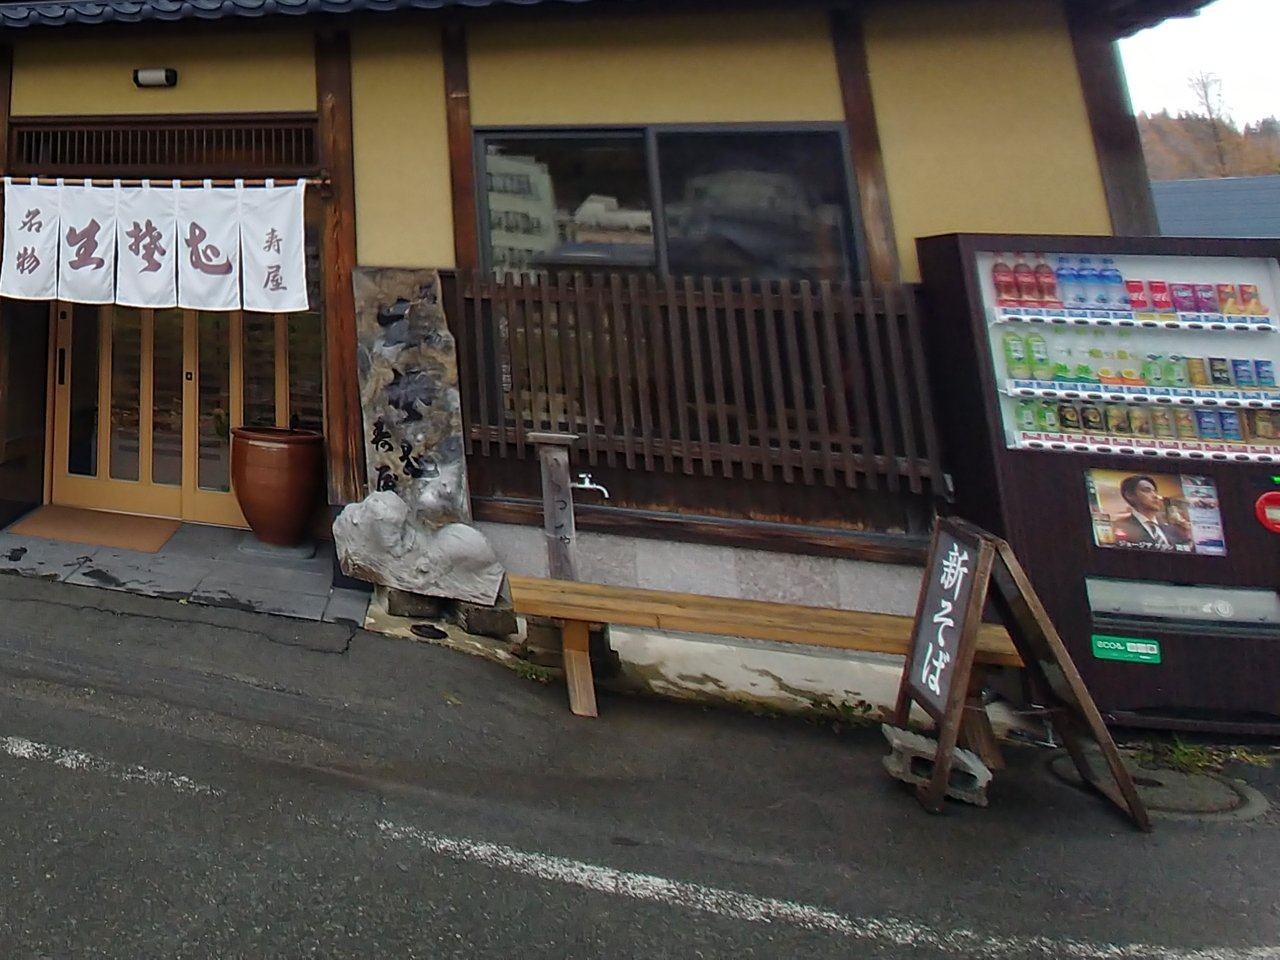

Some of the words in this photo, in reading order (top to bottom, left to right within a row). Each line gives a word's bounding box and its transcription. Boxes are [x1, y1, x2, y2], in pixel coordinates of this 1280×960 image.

[16, 208, 43, 276] 名物
[263, 227, 288, 292] 寿屋
[921, 542, 970, 696] 新そば
